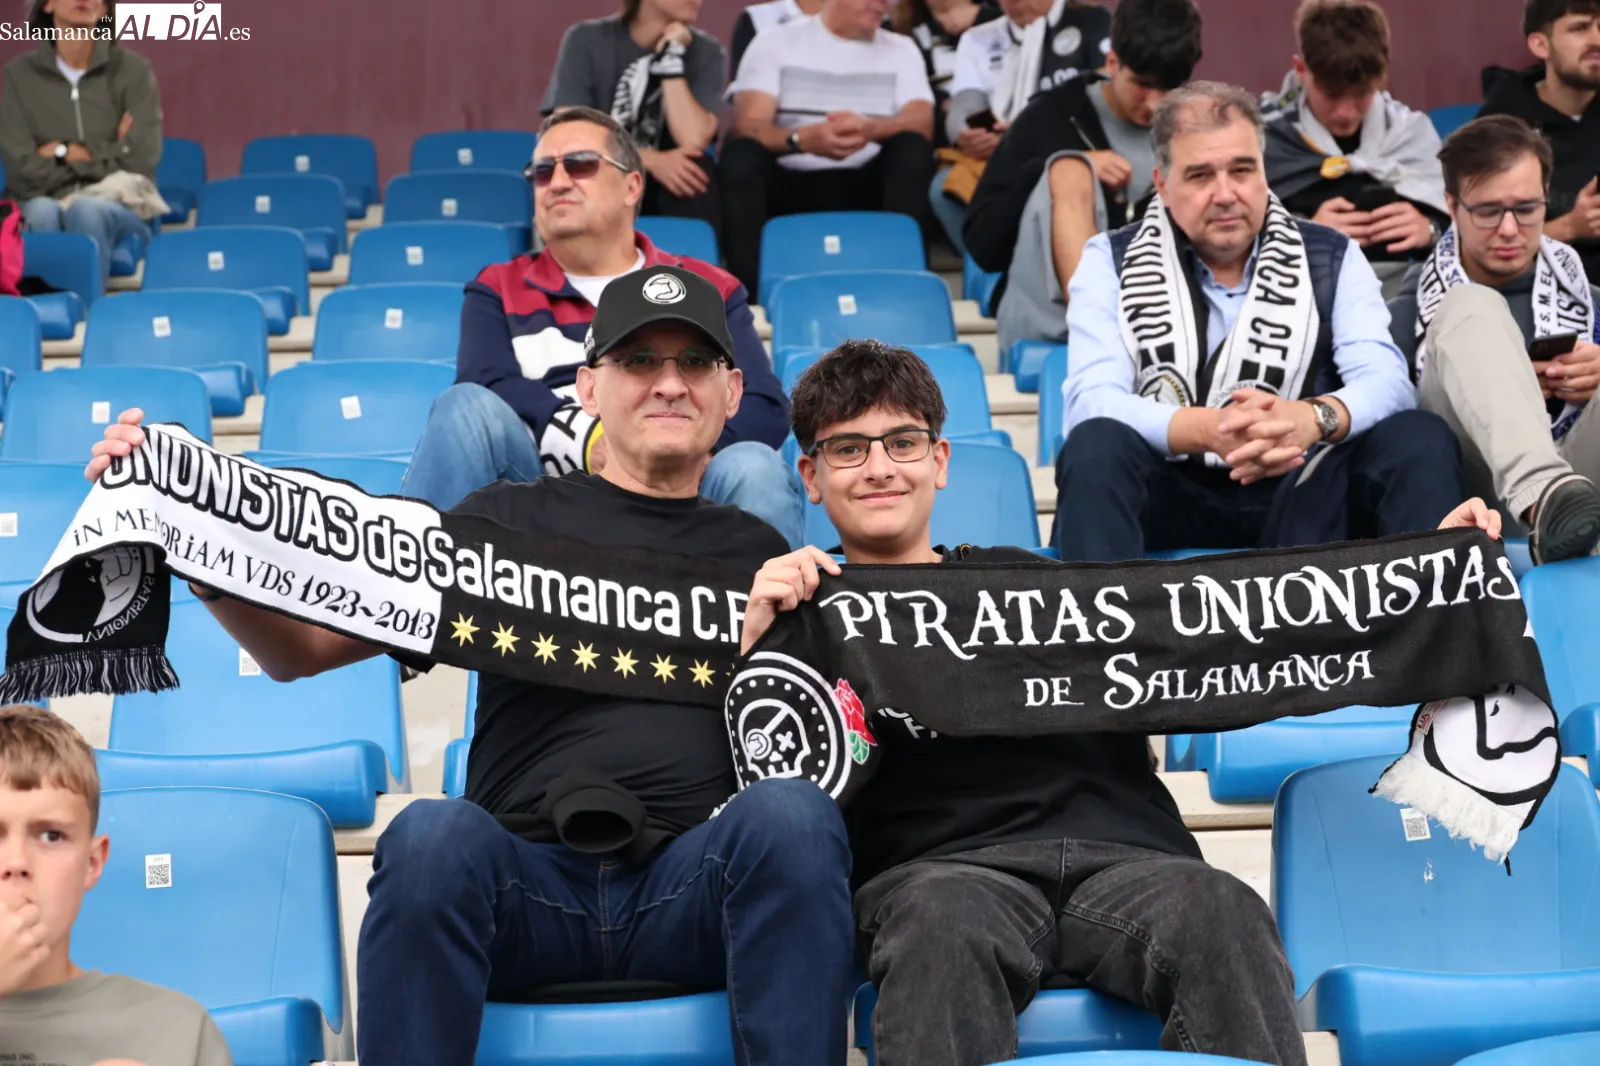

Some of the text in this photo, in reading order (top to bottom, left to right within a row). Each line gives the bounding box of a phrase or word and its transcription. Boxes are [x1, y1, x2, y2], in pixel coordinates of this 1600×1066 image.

[1247, 316, 1292, 362] CF
[100, 427, 358, 562] UNIONISTAS
[362, 514, 422, 583] de
[423, 526, 682, 638] Salamanca
[244, 555, 295, 598] VDS
[818, 544, 1522, 660] PIRATAS UNIONISTAS
[1022, 649, 1376, 710] DE SALAMANCA
